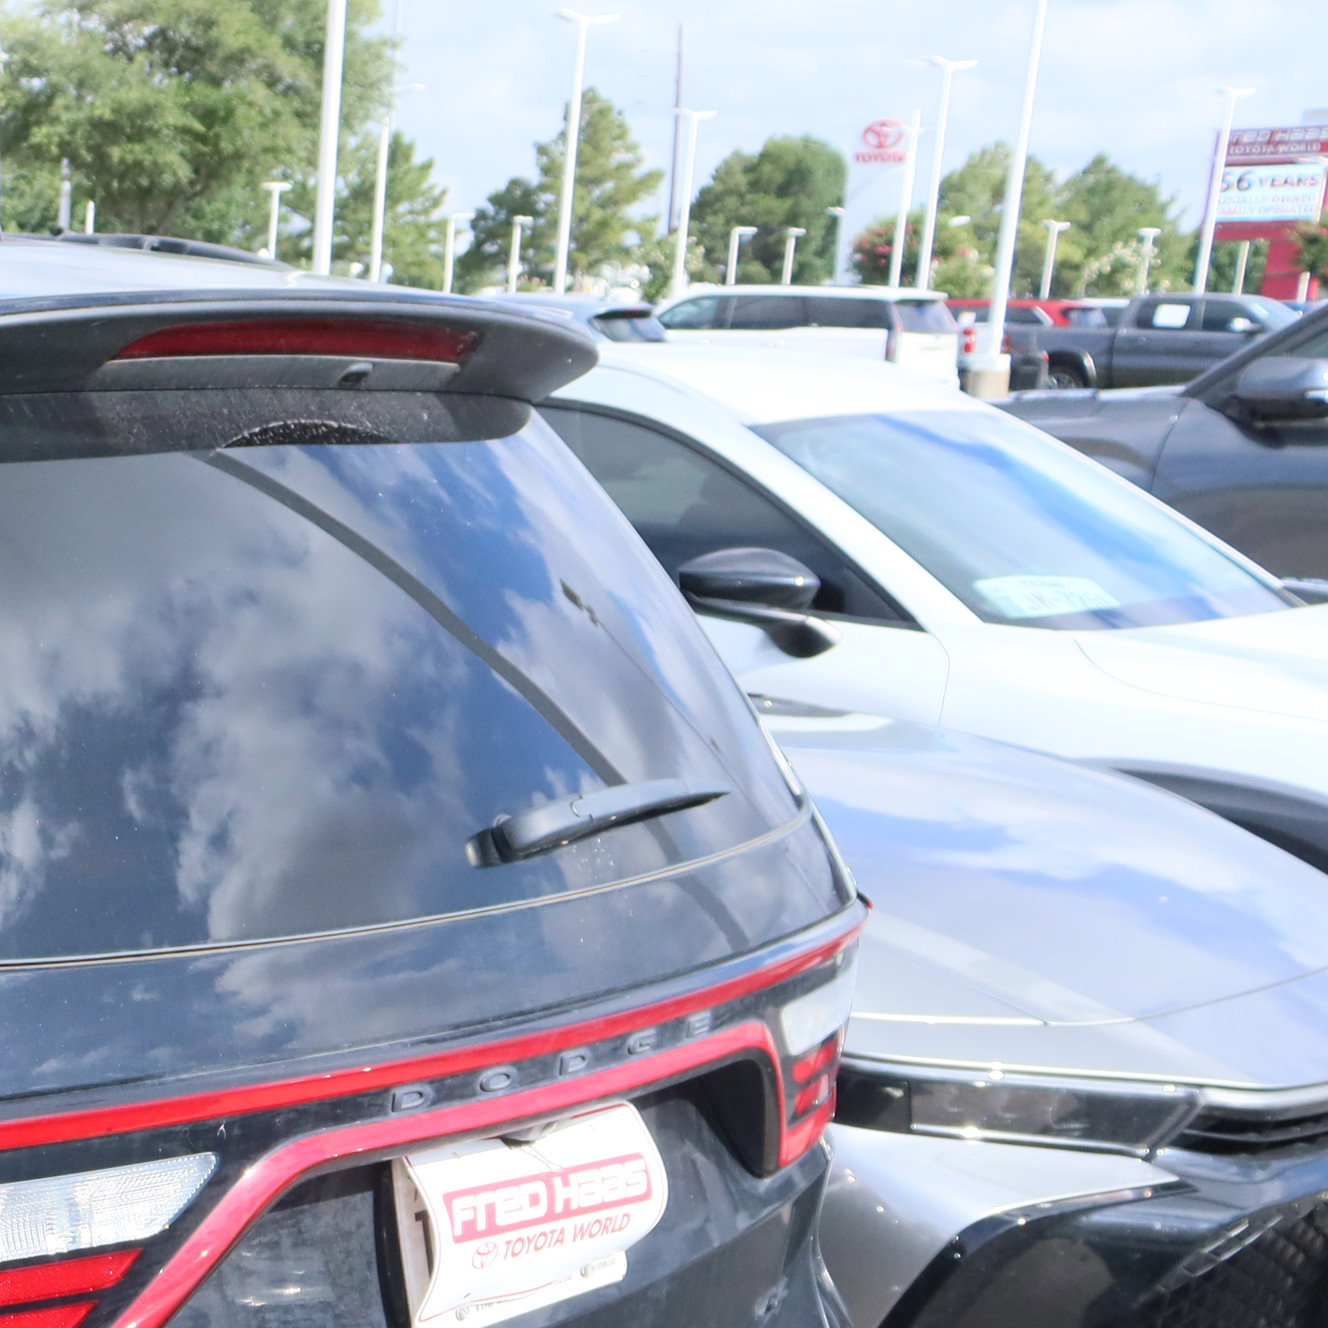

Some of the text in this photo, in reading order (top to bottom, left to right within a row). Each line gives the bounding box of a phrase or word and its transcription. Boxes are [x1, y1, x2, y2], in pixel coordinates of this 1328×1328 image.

[391, 1012, 713, 1113] DODGE
[503, 1213, 631, 1261] TOYOTA WORLD
